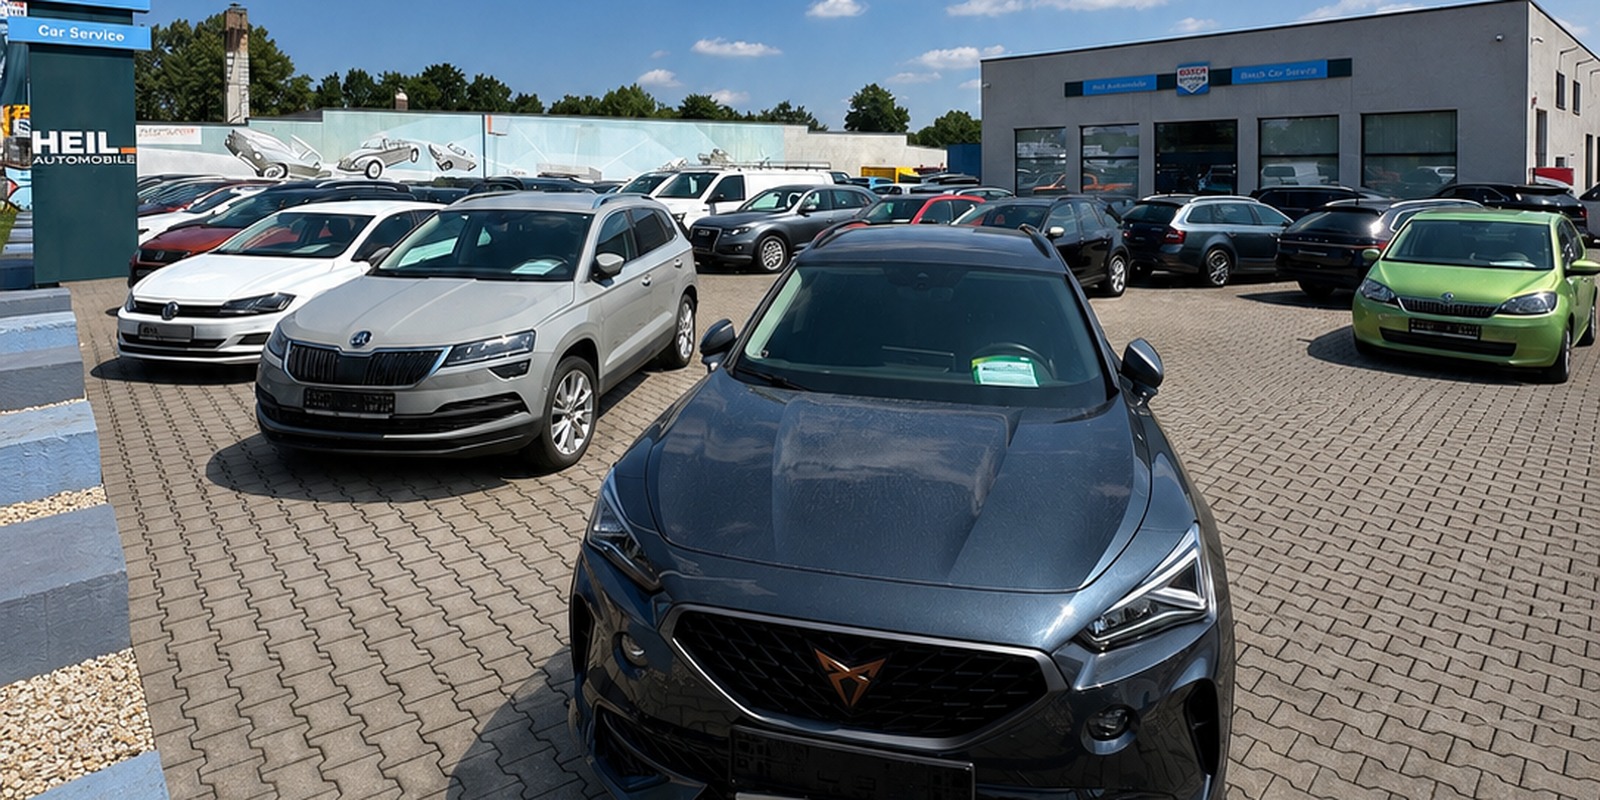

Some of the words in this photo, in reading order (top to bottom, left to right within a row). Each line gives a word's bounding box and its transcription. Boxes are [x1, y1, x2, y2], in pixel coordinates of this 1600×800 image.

[38, 24, 66, 38] Car
[70, 27, 125, 42] Service
[32, 130, 120, 154] HEIL
[32, 155, 136, 165] AUTOMOBILE
